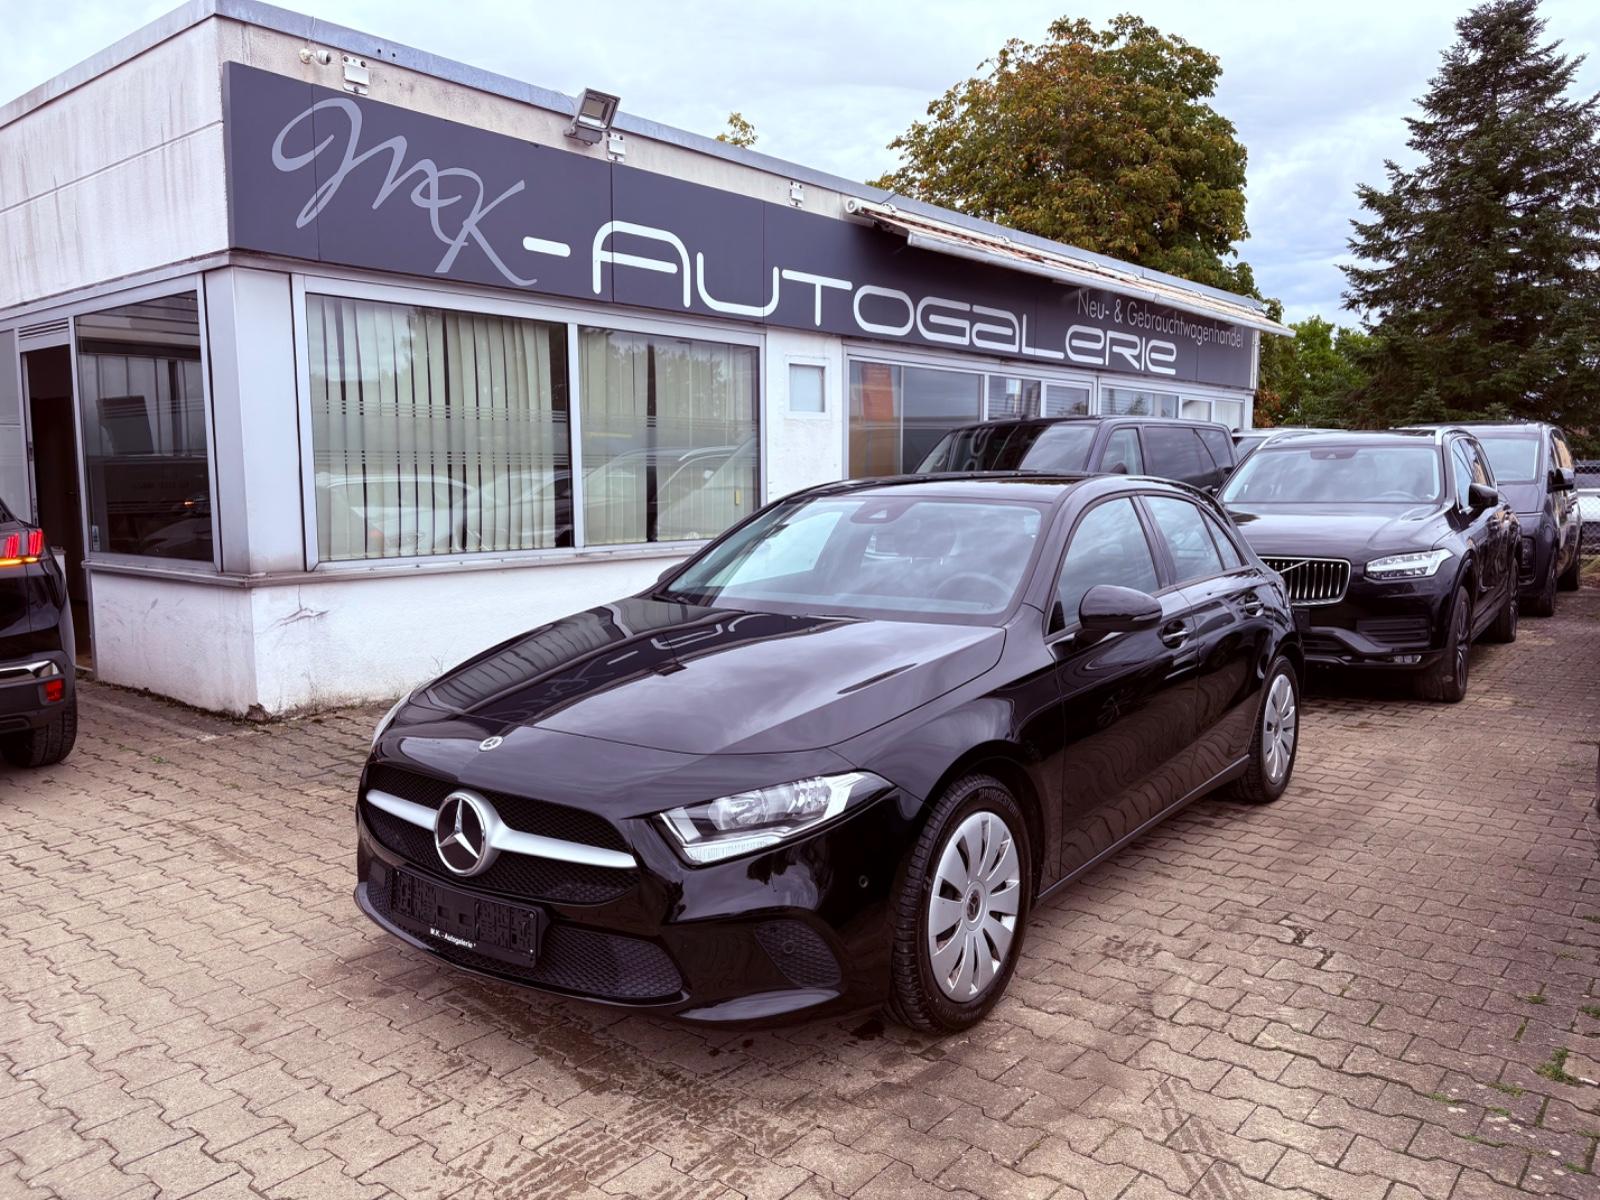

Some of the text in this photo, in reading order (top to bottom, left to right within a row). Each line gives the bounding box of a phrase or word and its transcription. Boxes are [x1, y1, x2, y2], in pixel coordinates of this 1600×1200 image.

[271, 97, 538, 287] MK
[1077, 287, 1244, 349] Neu- & Gebrauchtwagenhandel
